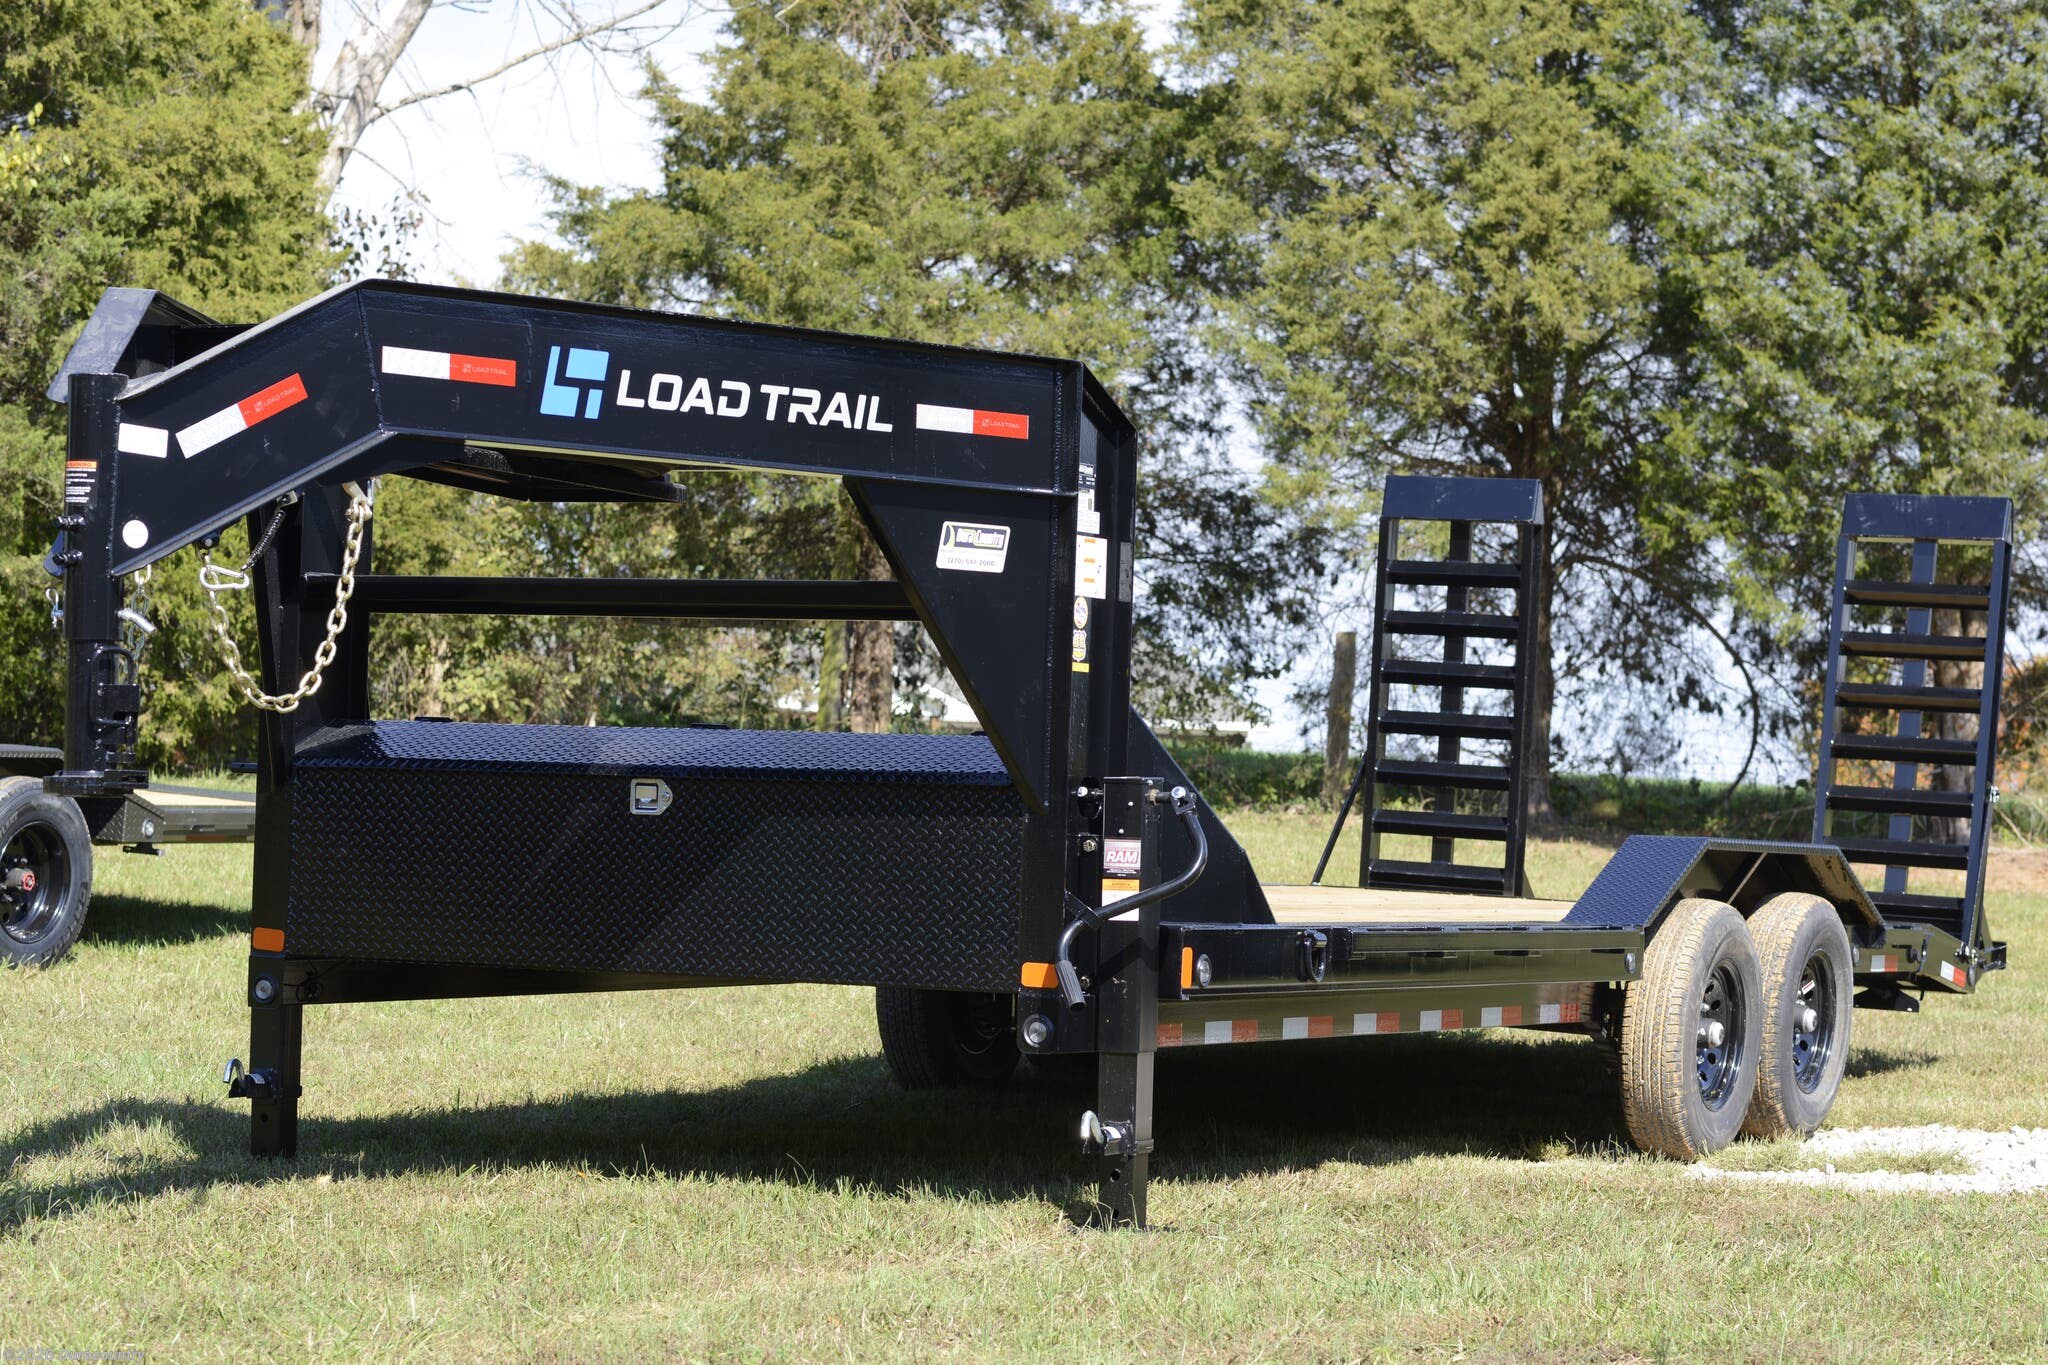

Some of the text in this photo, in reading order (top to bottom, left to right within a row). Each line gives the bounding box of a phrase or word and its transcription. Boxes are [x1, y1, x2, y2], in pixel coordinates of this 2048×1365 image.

[616, 369, 893, 433] LOAD TRAIL
[1106, 850, 1139, 864] RAM
